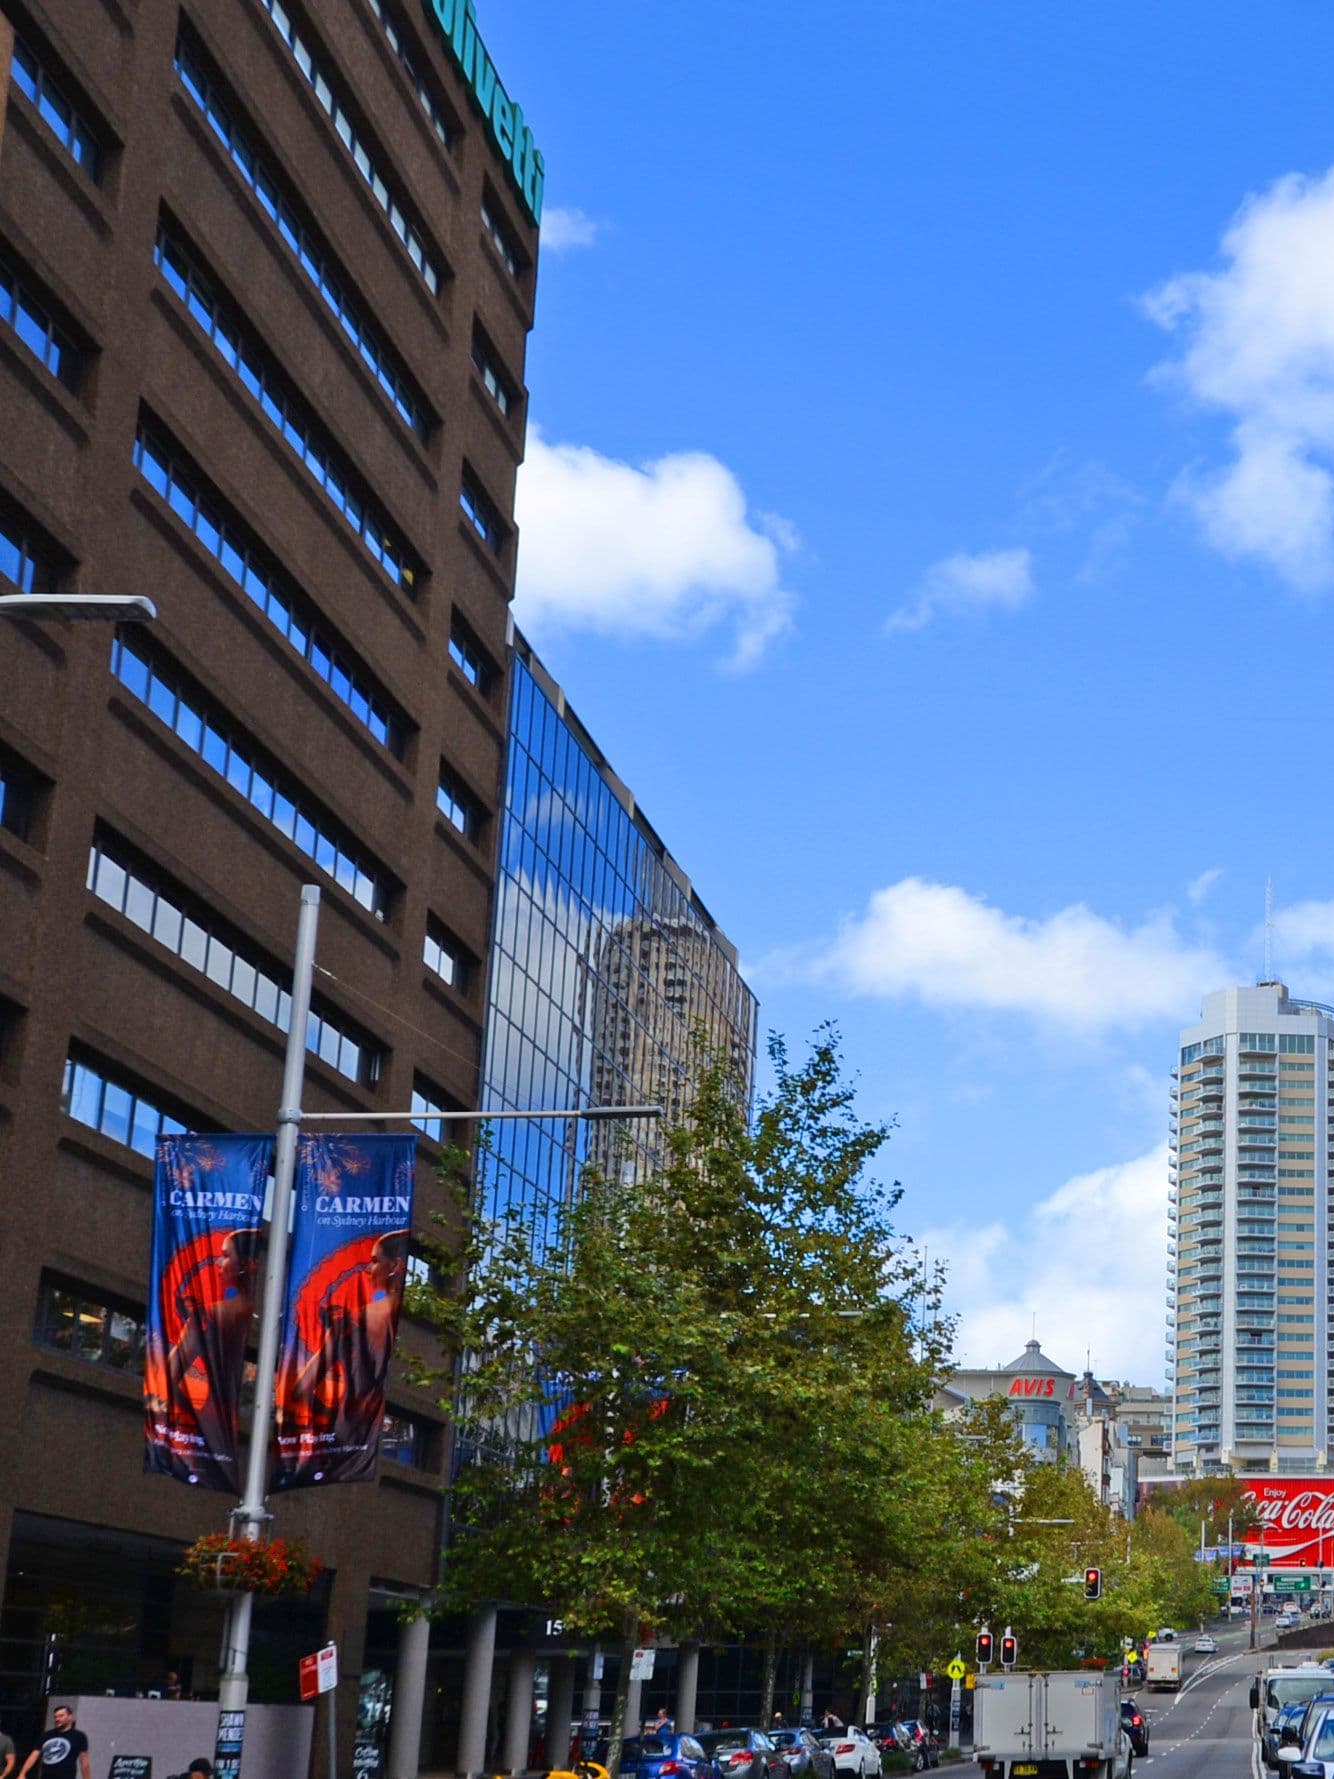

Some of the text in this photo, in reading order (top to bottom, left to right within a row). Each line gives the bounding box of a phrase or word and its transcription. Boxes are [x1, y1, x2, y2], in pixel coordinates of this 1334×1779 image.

[170, 1190, 262, 1212] CARMEN
[315, 1196, 411, 1213] CARMEN
[318, 1214, 407, 1227] on Sydney Harbour
[1009, 1378, 1055, 1397] AVIS
[1263, 1482, 1287, 1498] Enjoy
